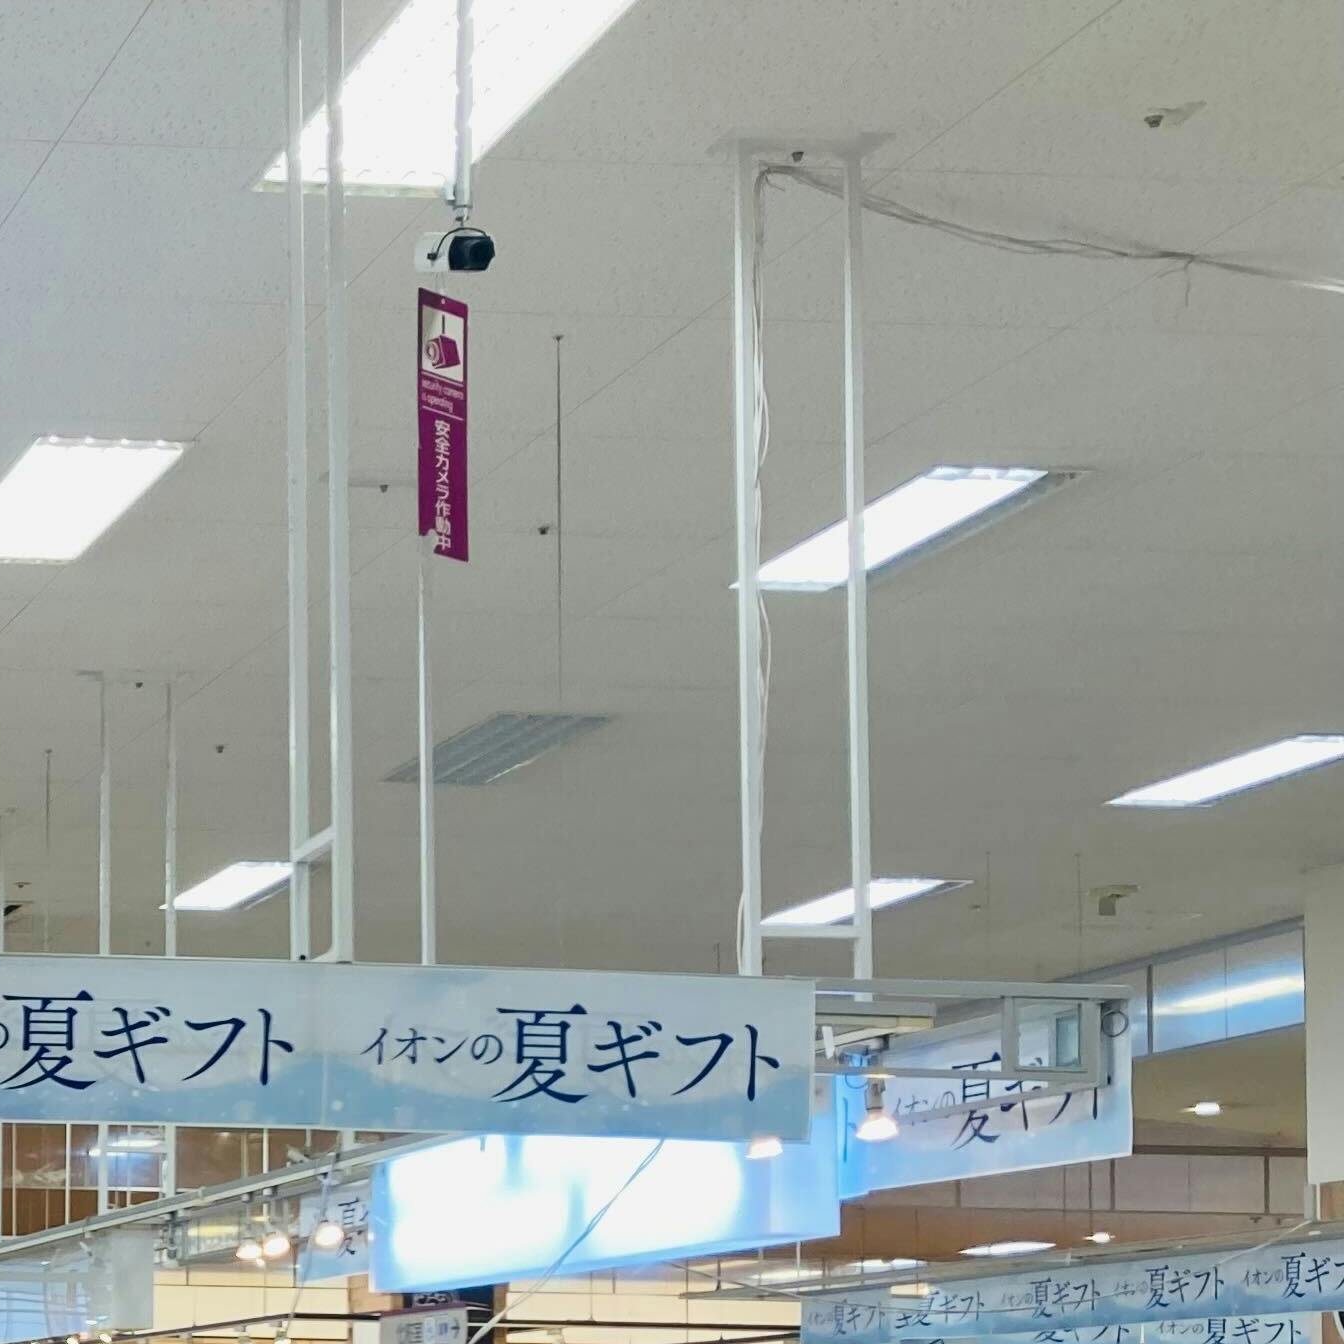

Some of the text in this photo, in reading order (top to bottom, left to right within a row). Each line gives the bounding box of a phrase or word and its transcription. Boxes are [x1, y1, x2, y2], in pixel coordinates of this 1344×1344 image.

[360, 1003, 781, 1104] イオンの夏ギフト
